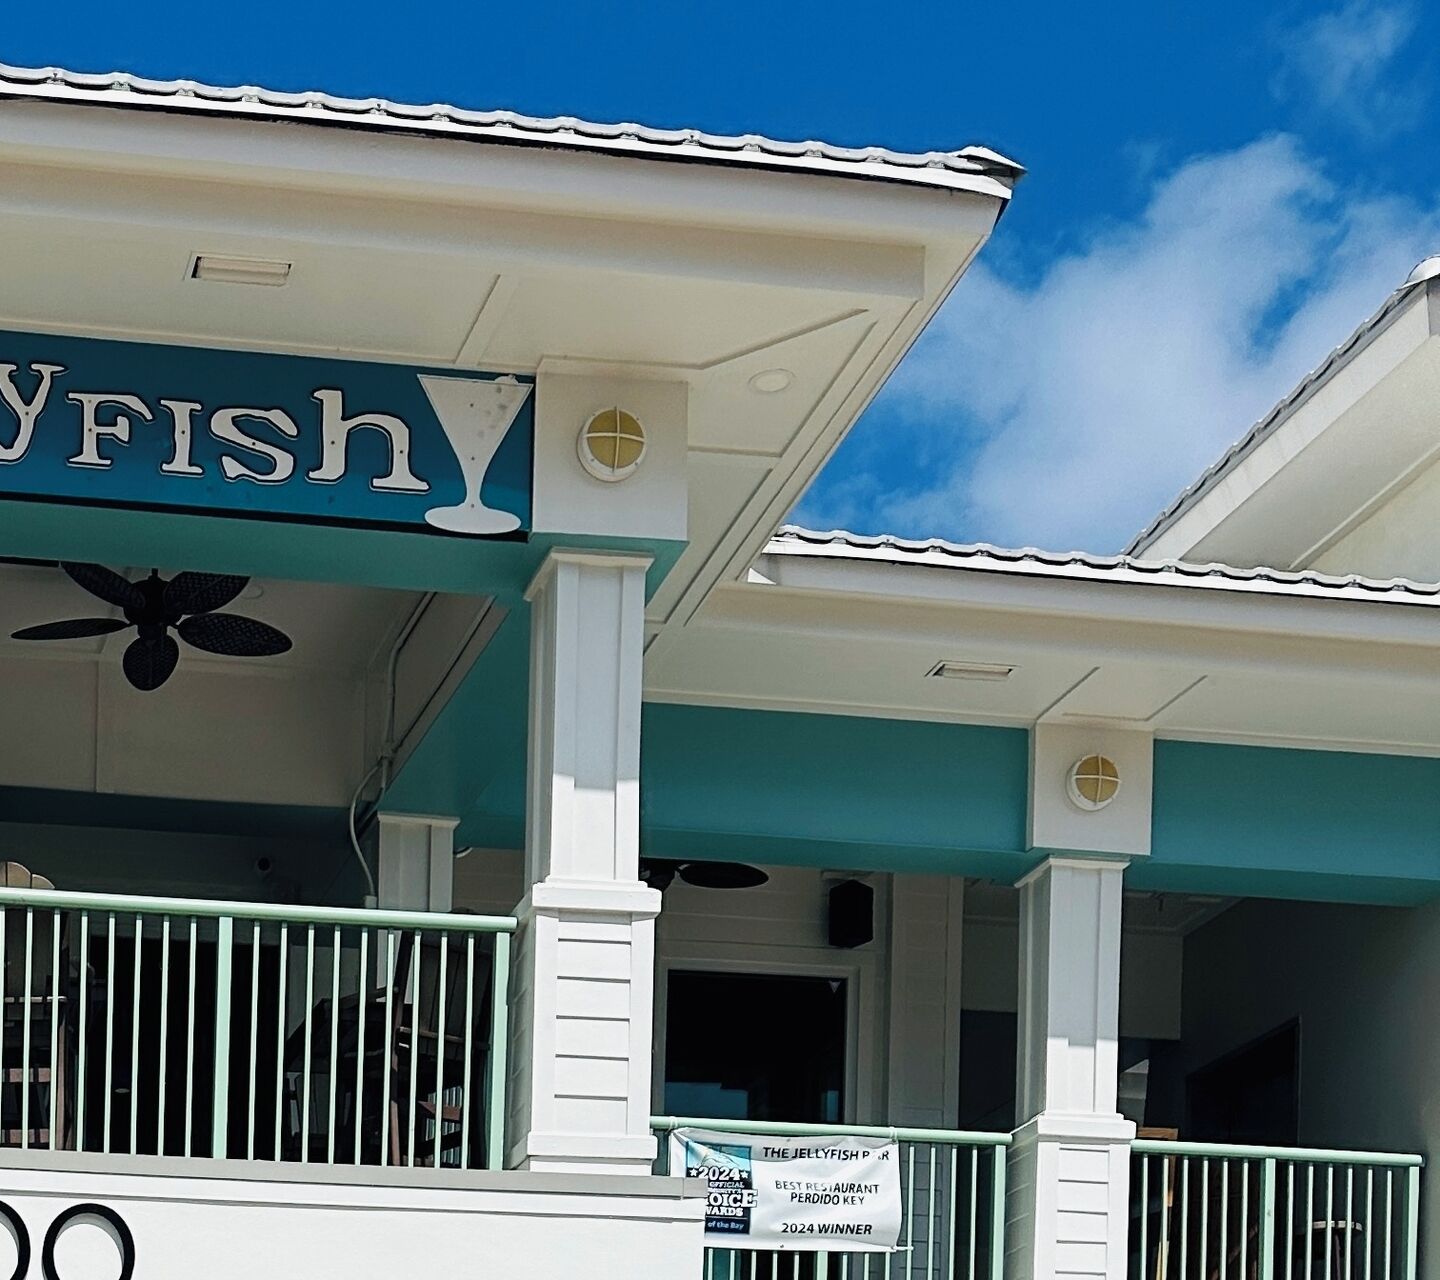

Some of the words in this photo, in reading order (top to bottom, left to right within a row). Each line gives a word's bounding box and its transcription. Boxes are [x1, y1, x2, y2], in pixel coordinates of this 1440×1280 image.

[763, 1146, 790, 1159] THE
[791, 1147, 859, 1161] JELLYFISH
[698, 1166, 741, 1181] 2024
[775, 1180, 801, 1191] BEST
[805, 1182, 880, 1195] RESTAURANT
[706, 1189, 758, 1208] OICE
[790, 1192, 840, 1206] PERDIDO
[843, 1195, 865, 1206] KEY
[730, 1222, 745, 1230] Bay
[781, 1222, 814, 1235] 2024
[818, 1223, 873, 1236] WINNER
